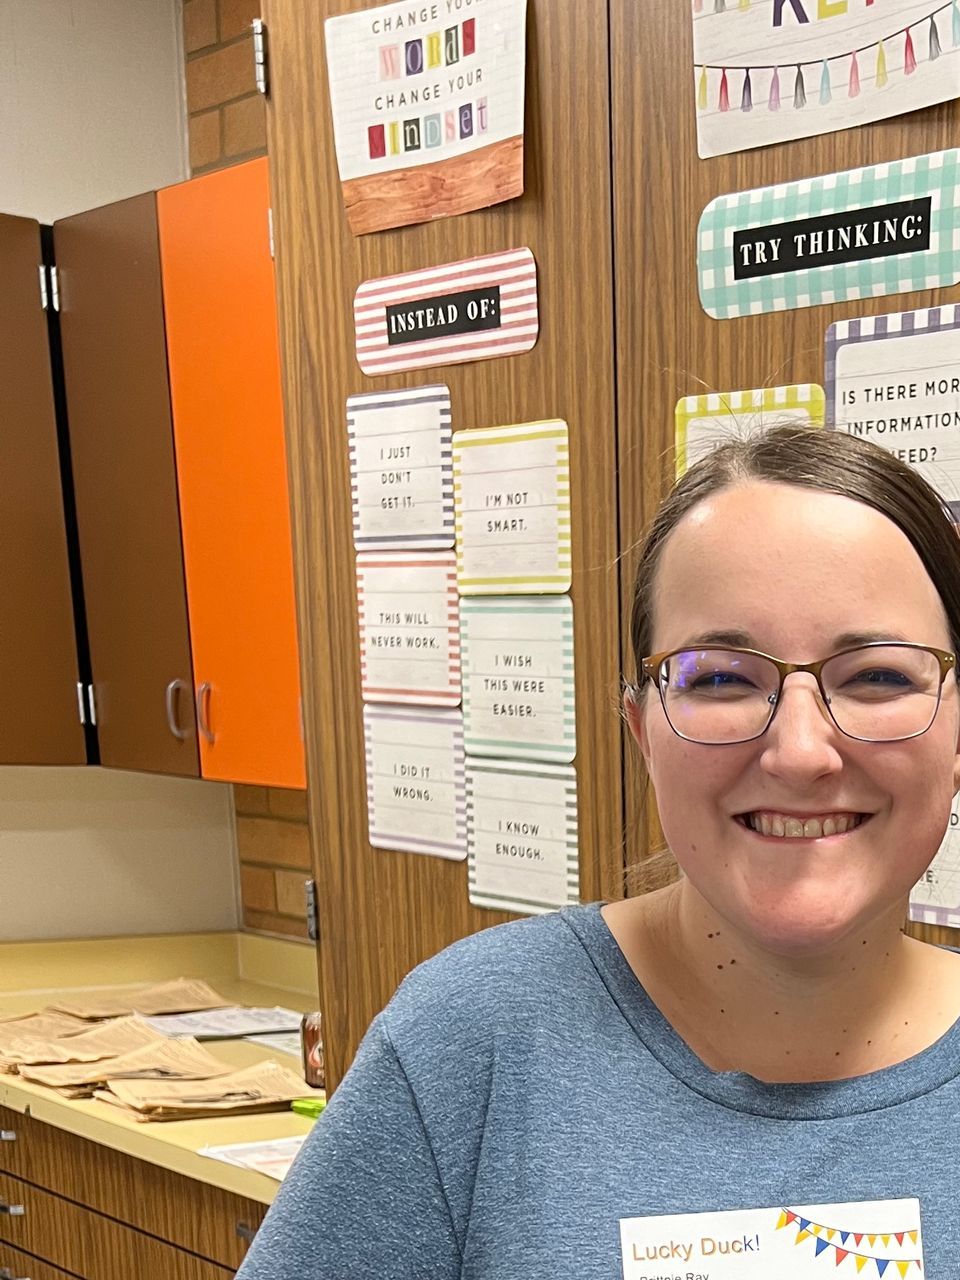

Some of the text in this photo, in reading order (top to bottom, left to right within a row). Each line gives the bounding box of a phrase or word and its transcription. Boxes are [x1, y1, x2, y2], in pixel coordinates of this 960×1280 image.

[371, 4, 438, 34] CHANGE
[374, 68, 482, 110] CHANGE YOUR
[739, 215, 923, 267] TRY THINKING:
[390, 298, 496, 334] INSTEAD OF:
[842, 390, 856, 405] IS
[864, 383, 917, 403] THERE
[380, 446, 411, 460] I JUST
[891, 447, 937, 463] EED?
[381, 471, 411, 484] DON'T
[381, 496, 416, 510] GET IT.
[485, 491, 528, 507] I'M NOT
[487, 518, 528, 533] SMART.
[379, 612, 429, 625] THIS WILL
[371, 636, 440, 649] NEVER WORK.
[495, 655, 532, 667] I WISH
[484, 679, 545, 693] THIS WERE
[493, 703, 537, 718] EASIER.
[393, 763, 431, 777] I DID IT
[393, 786, 433, 802] WRONG.
[498, 821, 540, 836] I KNOW
[495, 843, 545, 861] ENOUGH.
[633, 1234, 760, 1262] Lucky Duck!
